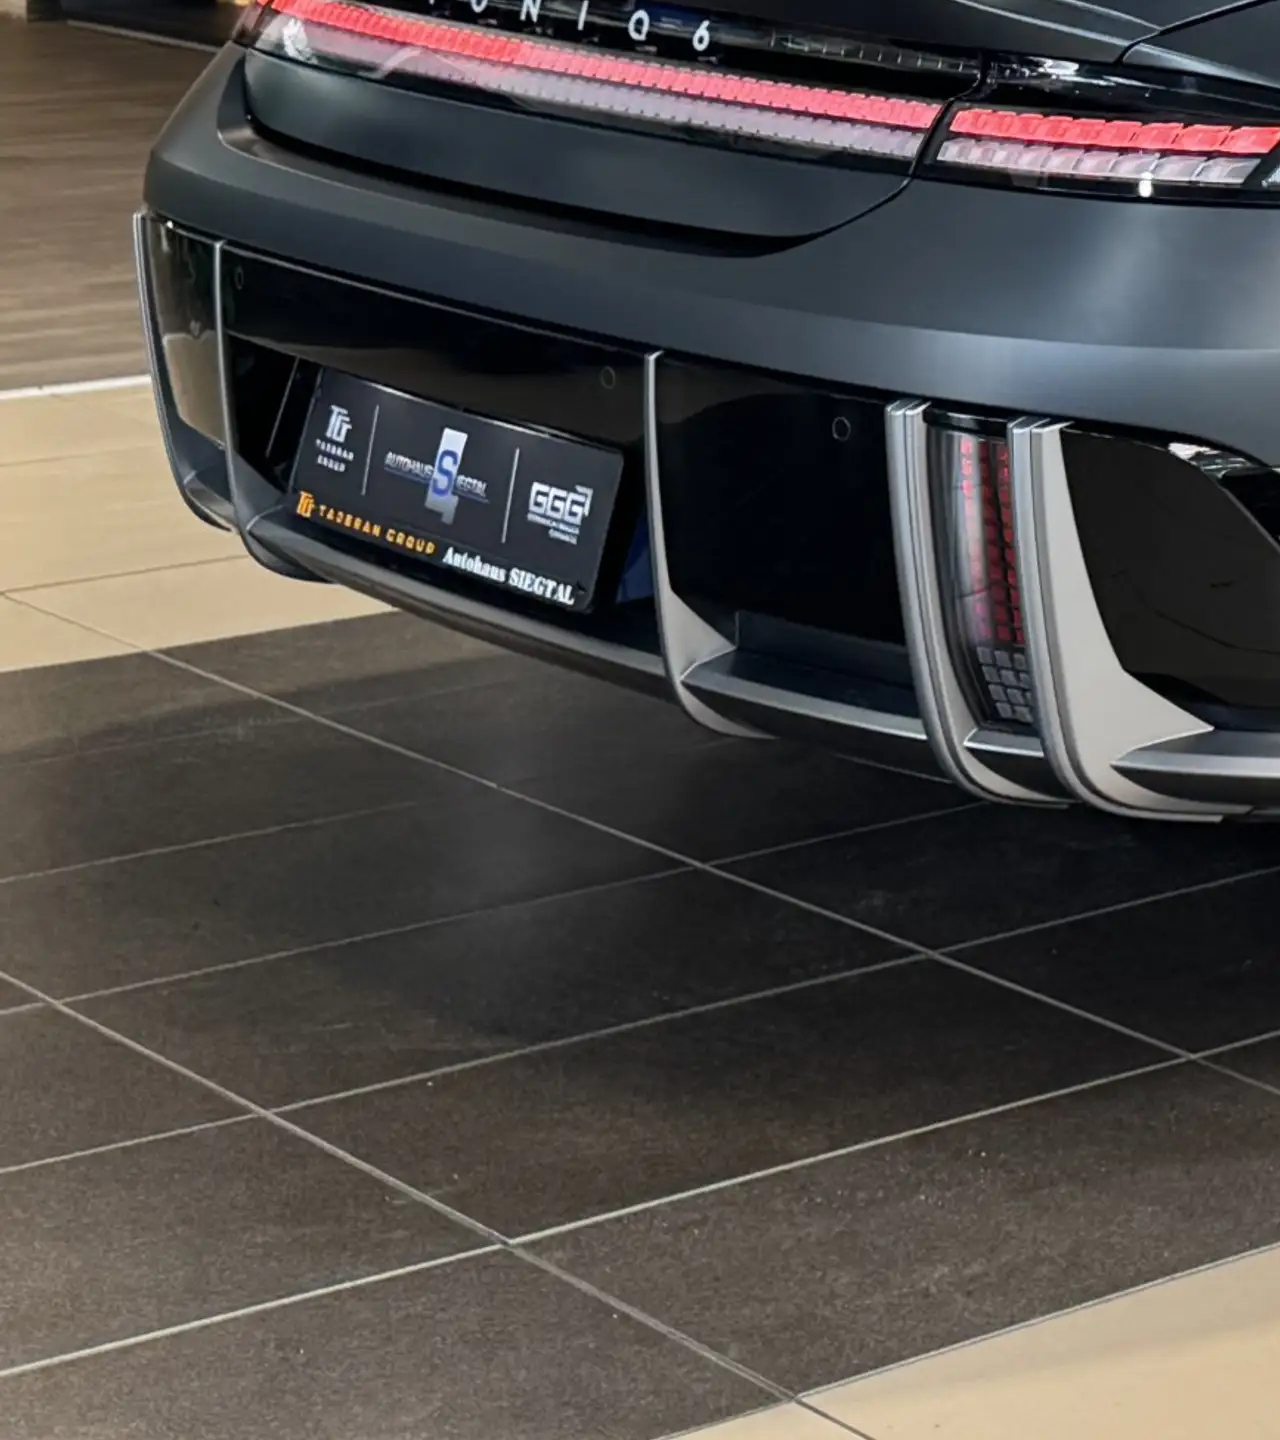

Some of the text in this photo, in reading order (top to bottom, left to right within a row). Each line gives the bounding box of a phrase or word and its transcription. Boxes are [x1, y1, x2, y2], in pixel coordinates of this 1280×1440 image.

[692, 19, 711, 52] 6
[442, 547, 575, 605] Autohaus SIEGTAL
